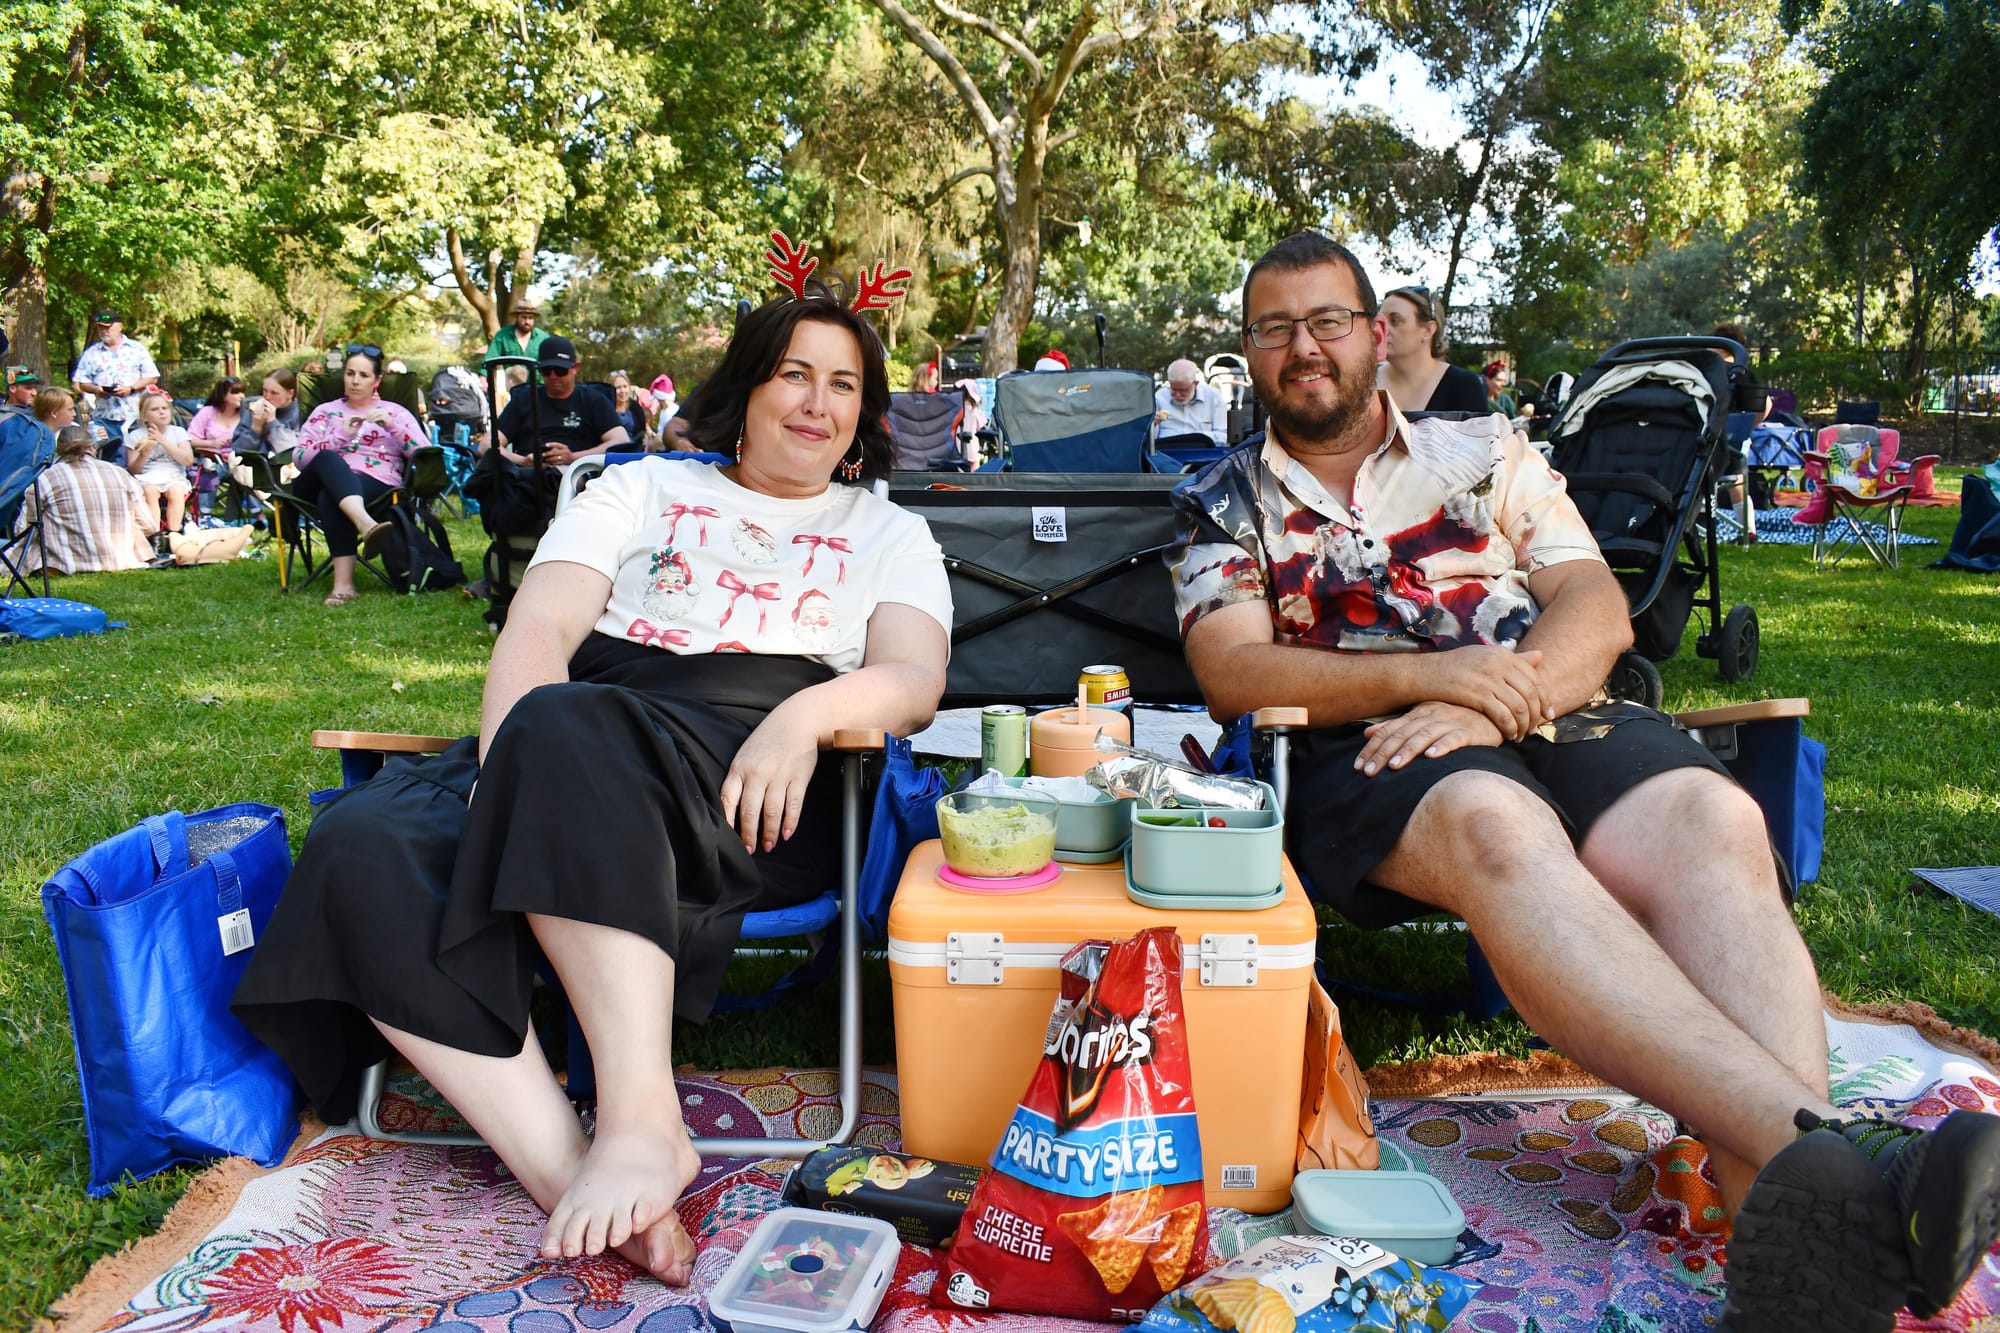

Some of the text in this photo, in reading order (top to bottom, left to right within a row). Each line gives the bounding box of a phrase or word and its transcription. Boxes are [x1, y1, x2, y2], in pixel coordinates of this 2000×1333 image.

[1035, 525, 1063, 533] LOVE
[1002, 1124, 1178, 1182] PARTY SIZE
[973, 1219, 1053, 1262] SUPREME
[983, 1205, 1044, 1243] CHEESE
